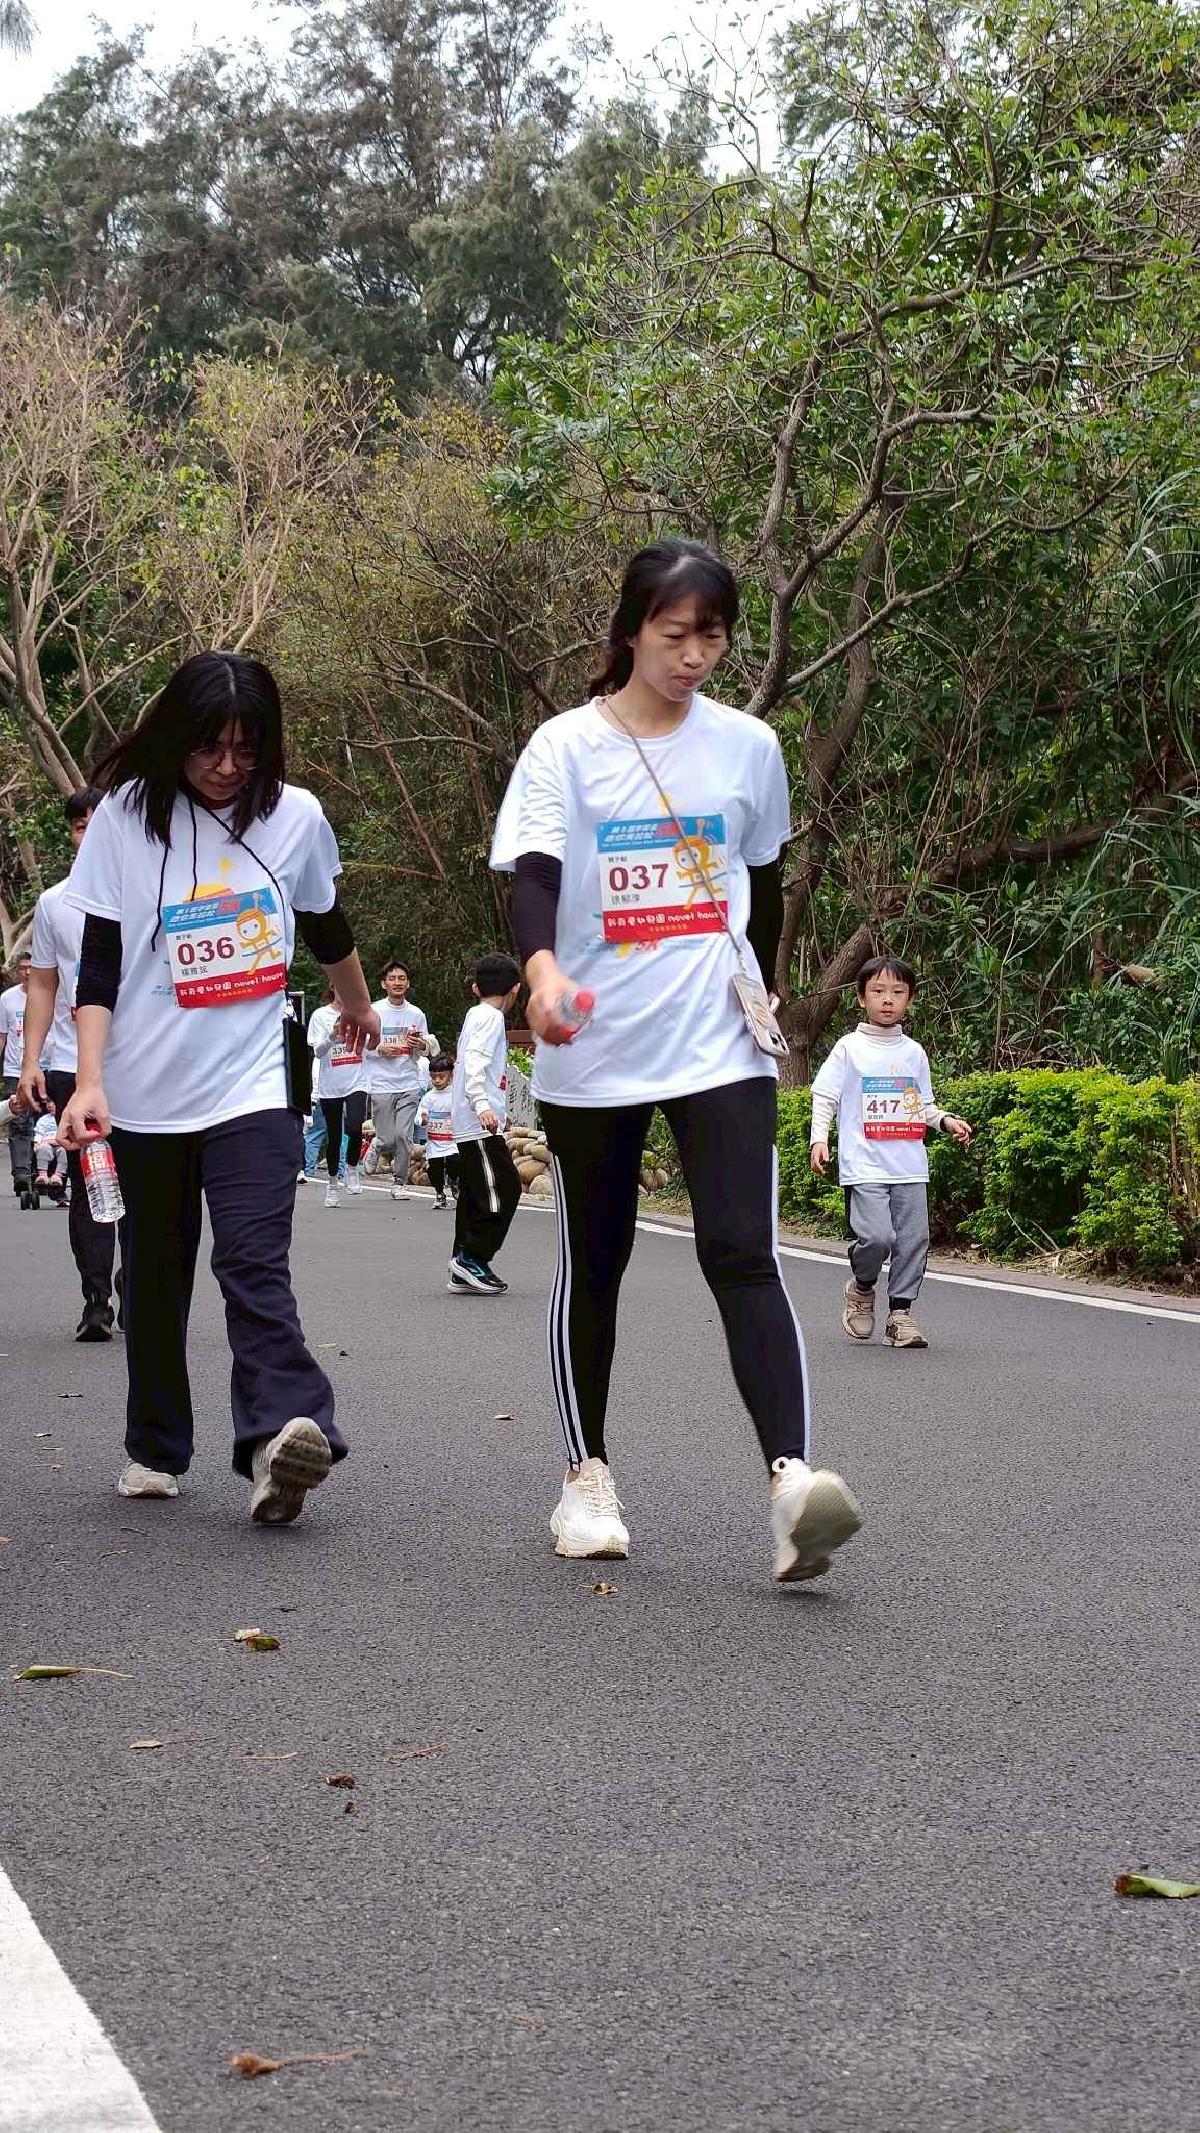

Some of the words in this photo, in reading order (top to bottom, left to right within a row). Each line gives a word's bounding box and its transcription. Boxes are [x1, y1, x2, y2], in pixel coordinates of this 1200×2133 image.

[609, 863, 669, 891] 037
[178, 936, 235, 965] 036
[234, 977, 259, 988] novel
[866, 1099, 901, 1114] 417
